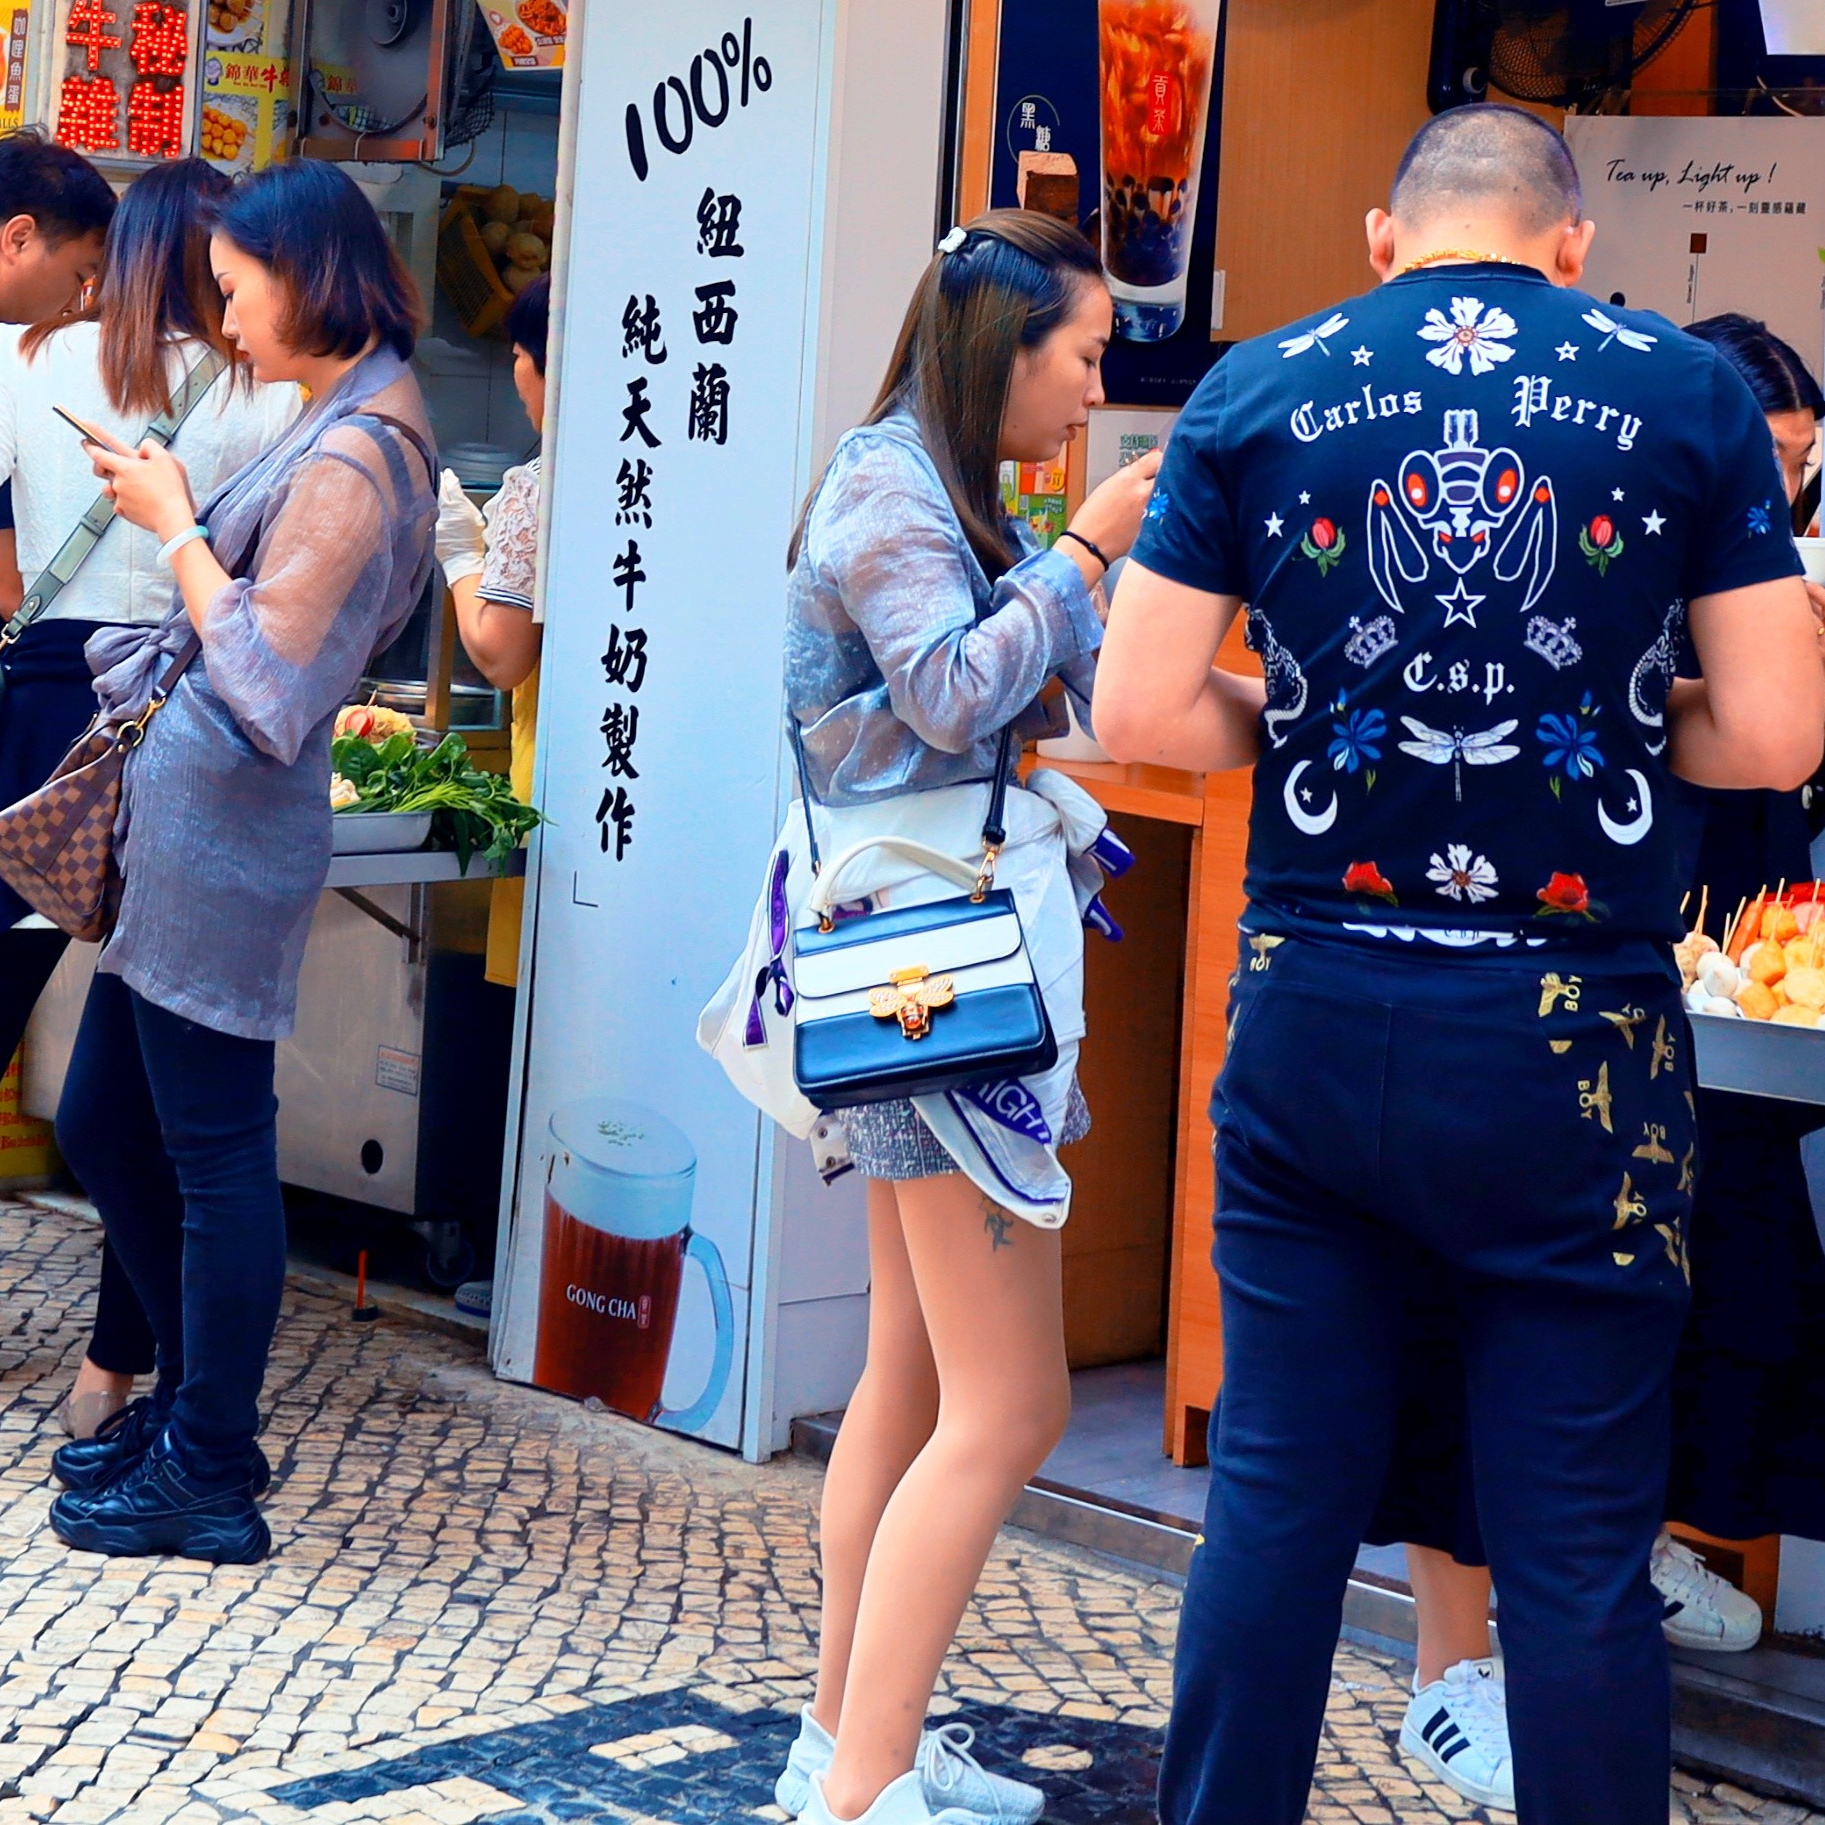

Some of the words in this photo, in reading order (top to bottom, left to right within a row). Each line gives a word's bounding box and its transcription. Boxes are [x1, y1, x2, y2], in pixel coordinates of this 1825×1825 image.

[625, 18, 772, 180] 100%
[1607, 159, 1635, 183] Tea
[1642, 171, 1669, 192] up,
[1678, 161, 1734, 192] Light
[1736, 173, 1761, 192] up
[689, 188, 745, 446] 紐西蘭
[1291, 385, 1423, 442] Carlos
[1514, 375, 1642, 451] Perry
[595, 295, 666, 861] 純天然牛奶製作
[1249, 957, 1271, 971] BOY
[1564, 975, 1582, 1011] BOY
[1665, 1032, 1675, 1072] BOY
[1578, 1080, 1592, 1120] BOY
[1644, 1122, 1665, 1139] BOY
[566, 1284, 606, 1314] GONG
[608, 1298, 636, 1320] CHA
